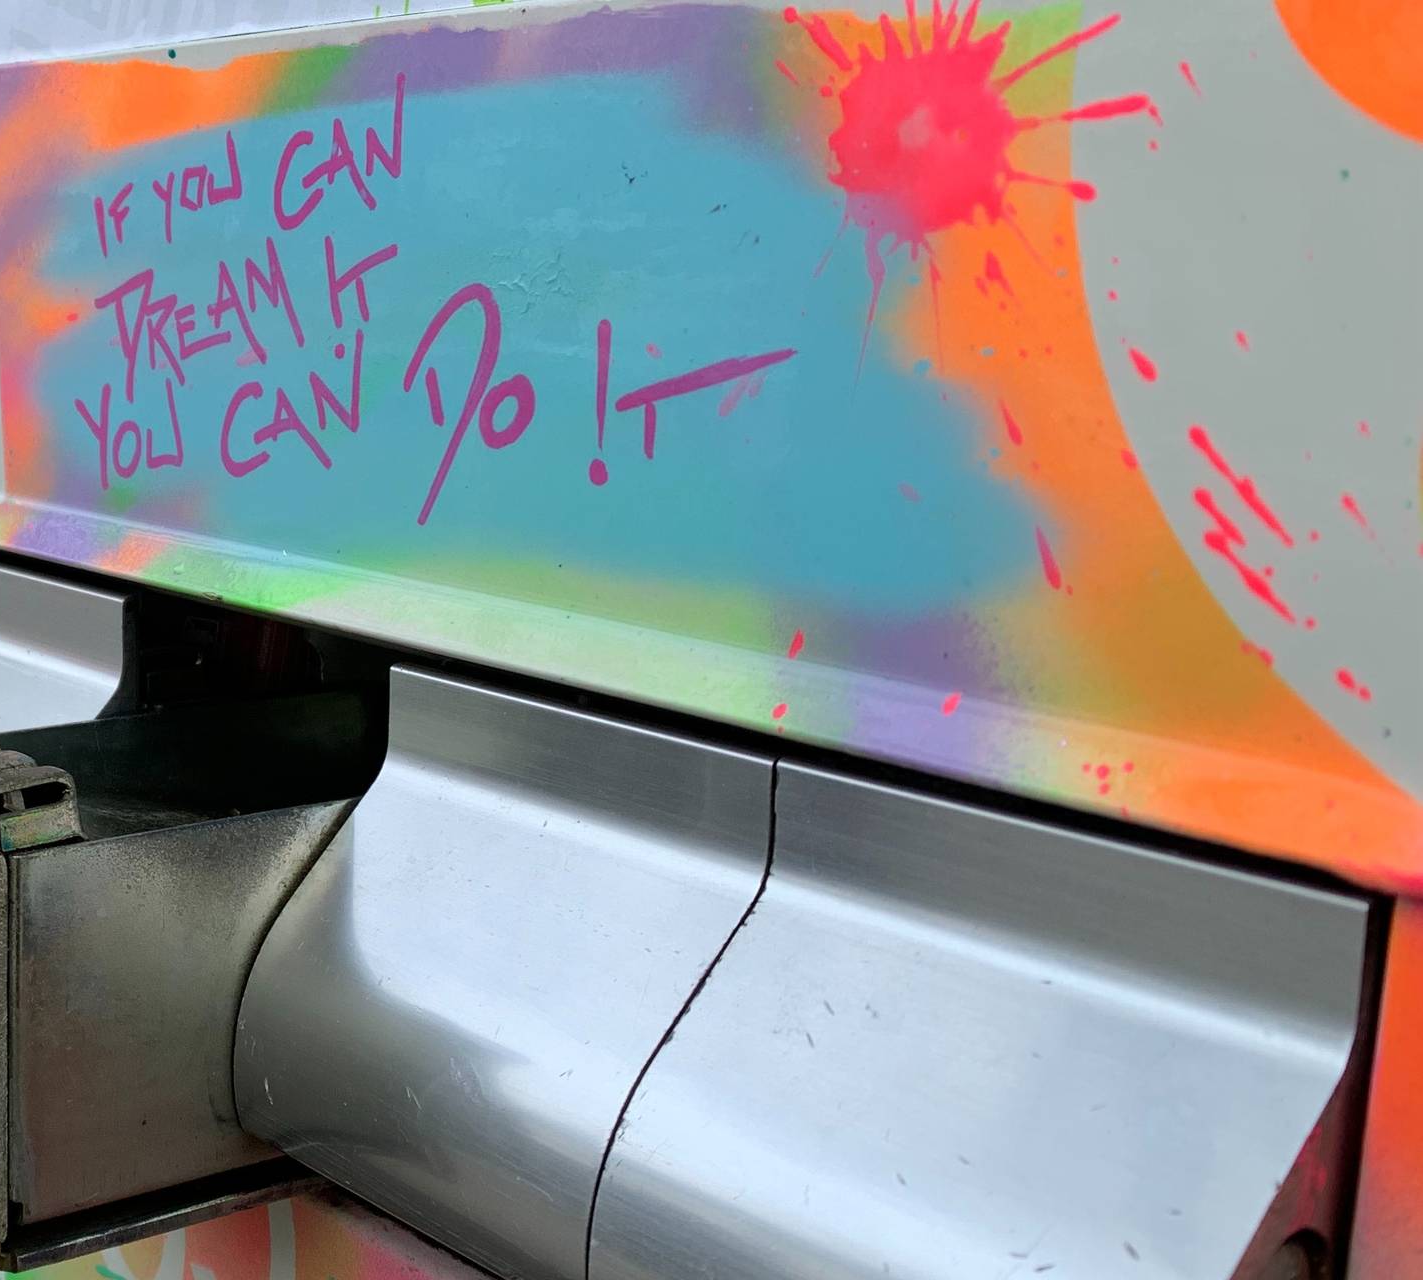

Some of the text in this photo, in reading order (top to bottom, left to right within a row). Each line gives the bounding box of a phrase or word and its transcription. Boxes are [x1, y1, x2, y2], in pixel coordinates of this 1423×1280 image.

[93, 73, 406, 256] IF YOU CAN
[75, 380, 184, 489] YOU
[220, 329, 364, 477] CAN
[402, 284, 535, 525] DO
[94, 237, 305, 403] DREAM
